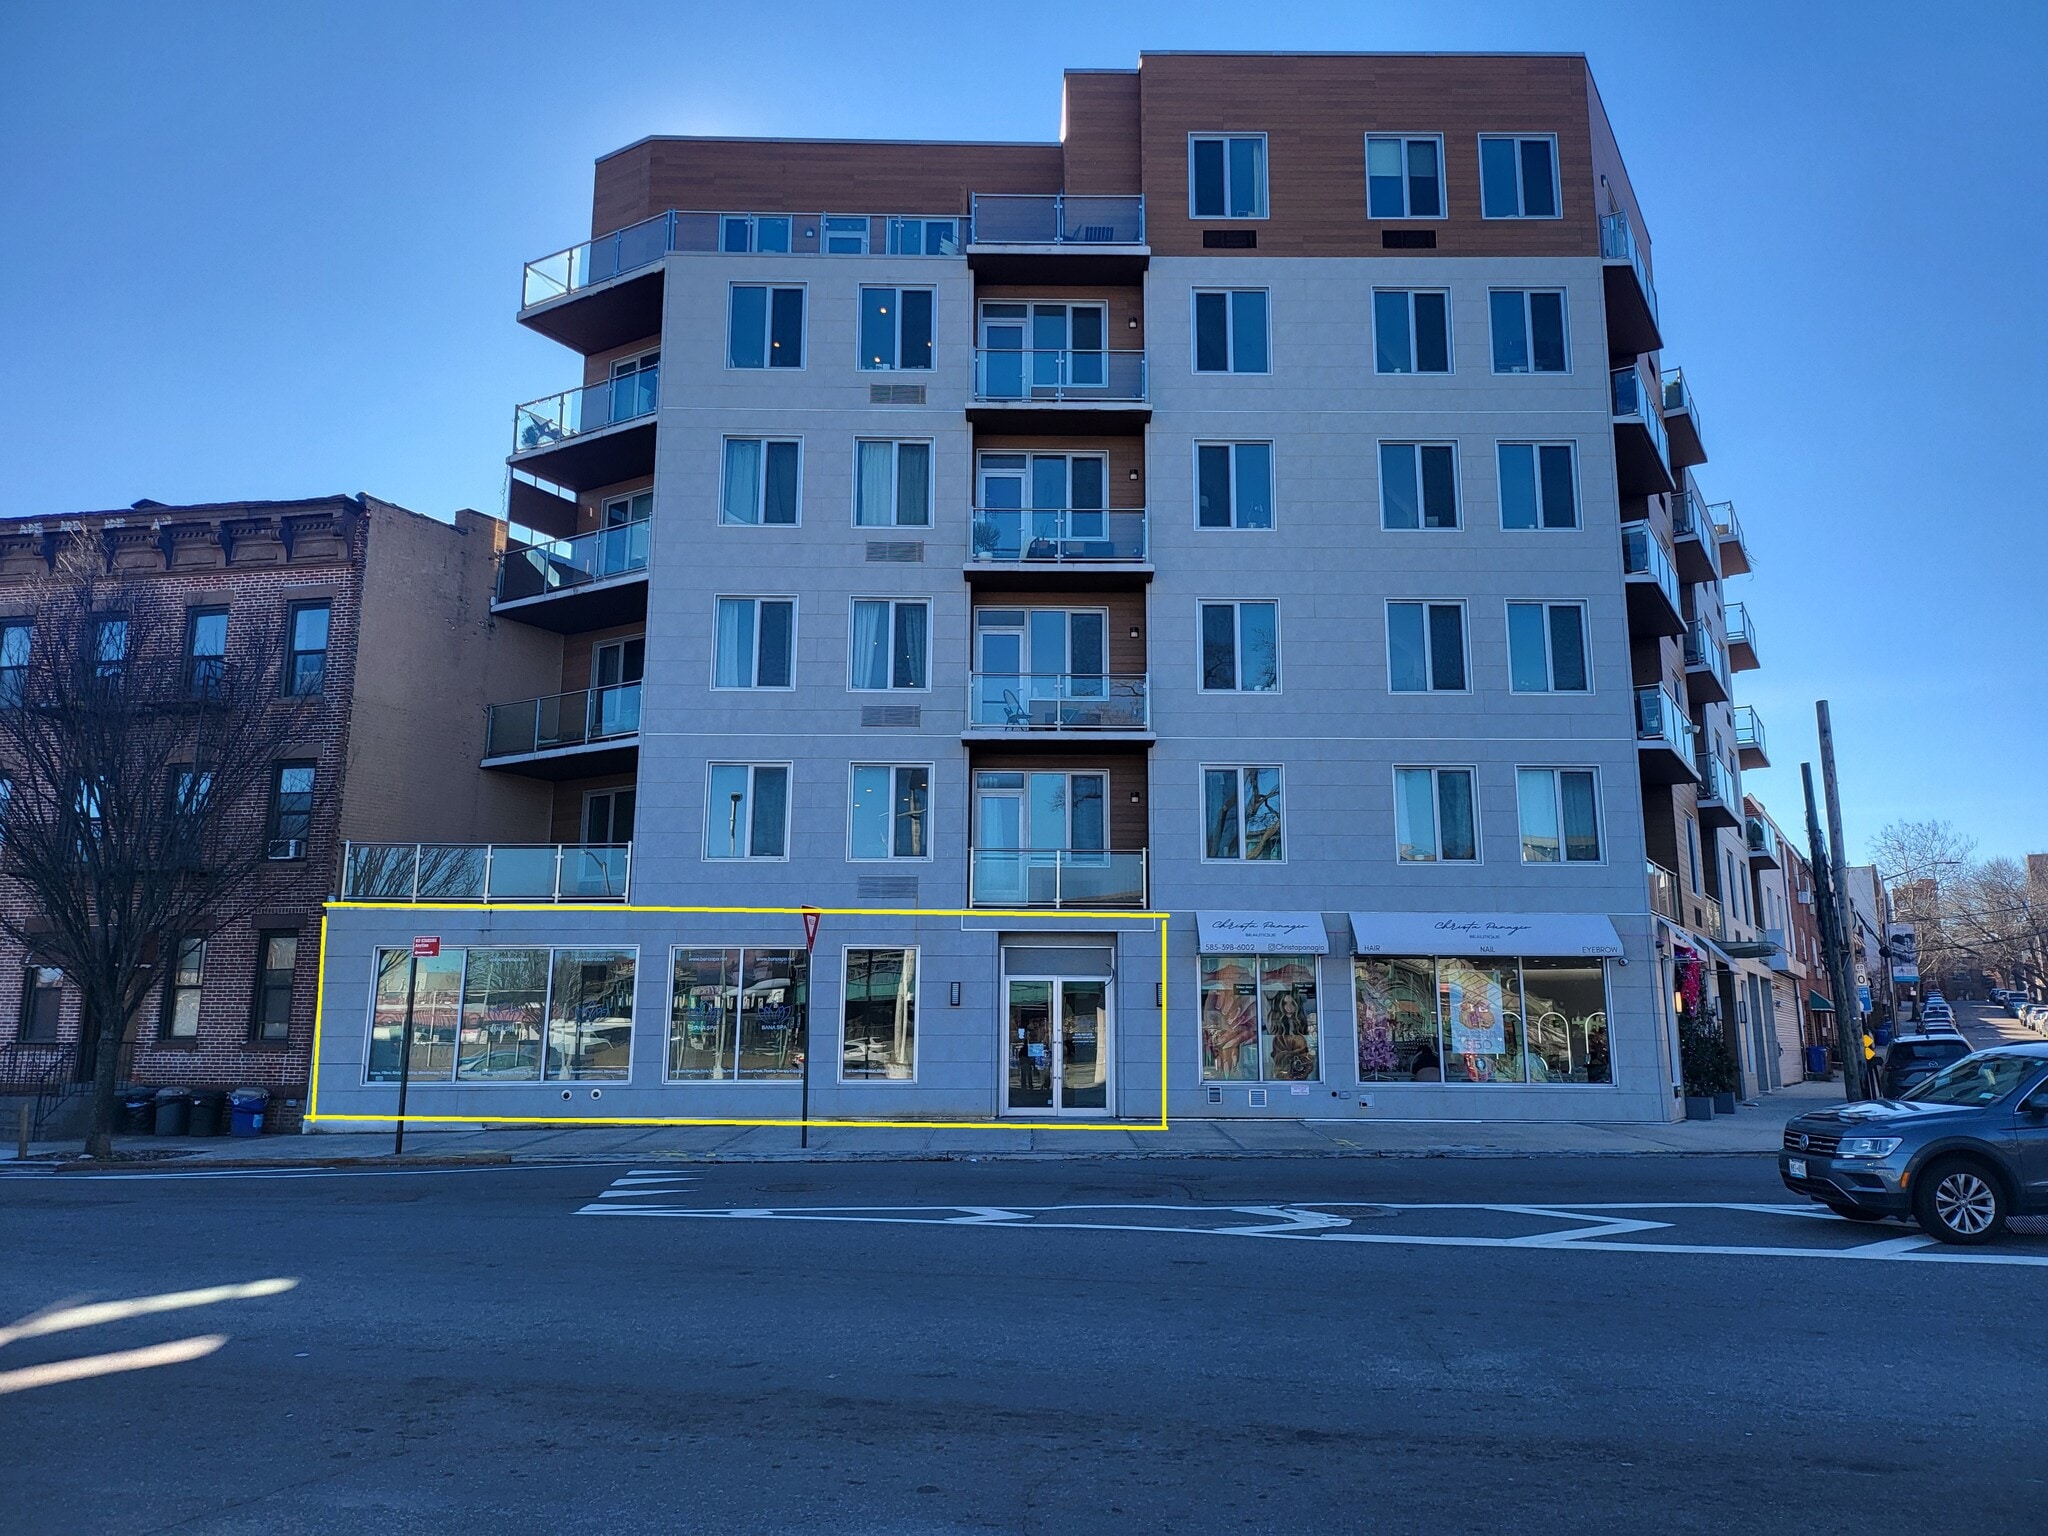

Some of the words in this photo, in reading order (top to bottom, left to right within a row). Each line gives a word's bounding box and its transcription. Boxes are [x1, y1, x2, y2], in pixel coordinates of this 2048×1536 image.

[1211, 918, 1258, 932] Christa
[1434, 919, 1481, 933] Christa
[1205, 943, 1256, 951] 585-398-6002
[1364, 944, 1381, 952] HAIR
[1463, 1039, 1493, 1051] $50
